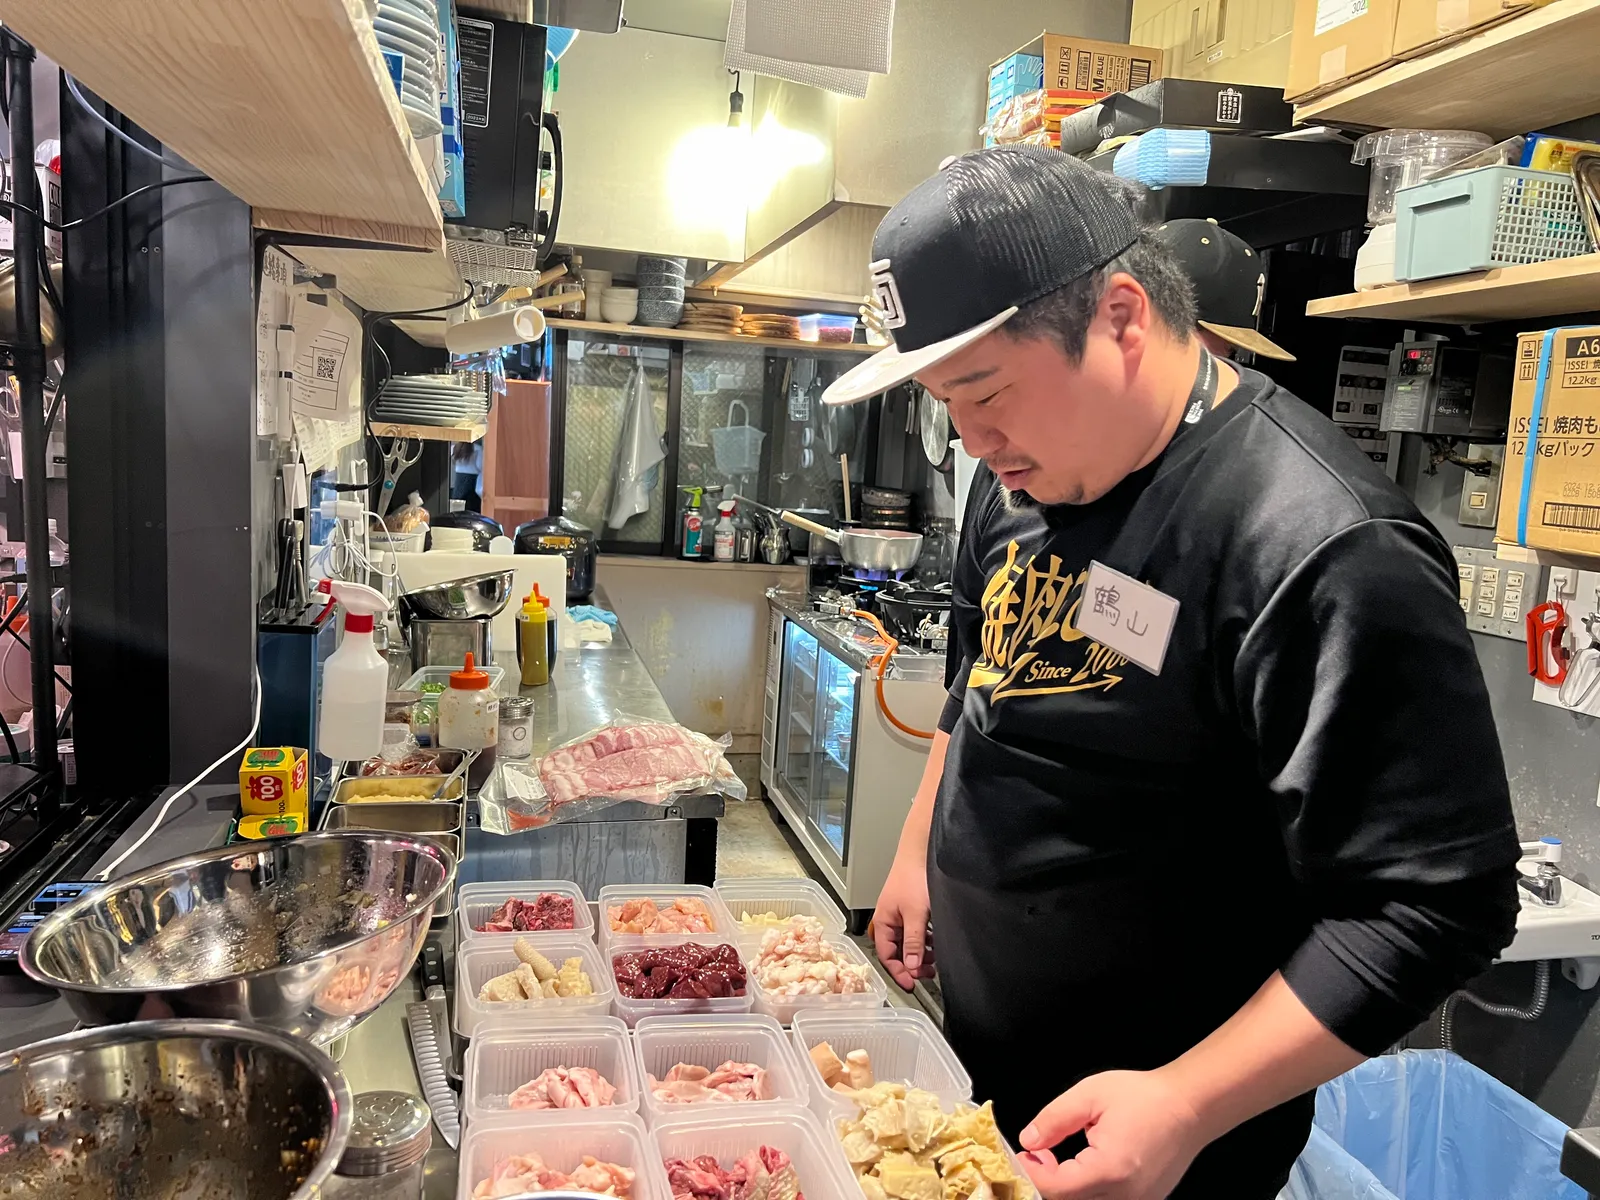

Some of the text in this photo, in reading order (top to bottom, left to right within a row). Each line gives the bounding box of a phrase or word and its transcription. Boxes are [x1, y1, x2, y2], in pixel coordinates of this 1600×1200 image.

[1568, 360, 1589, 370] ISSEI
[1552, 415, 1600, 434] 焼肉も
[1511, 440, 1595, 458] 12.kgパック
[1024, 660, 1072, 683] Since
[296, 762, 304, 788] 100
[260, 776, 275, 799] 100
